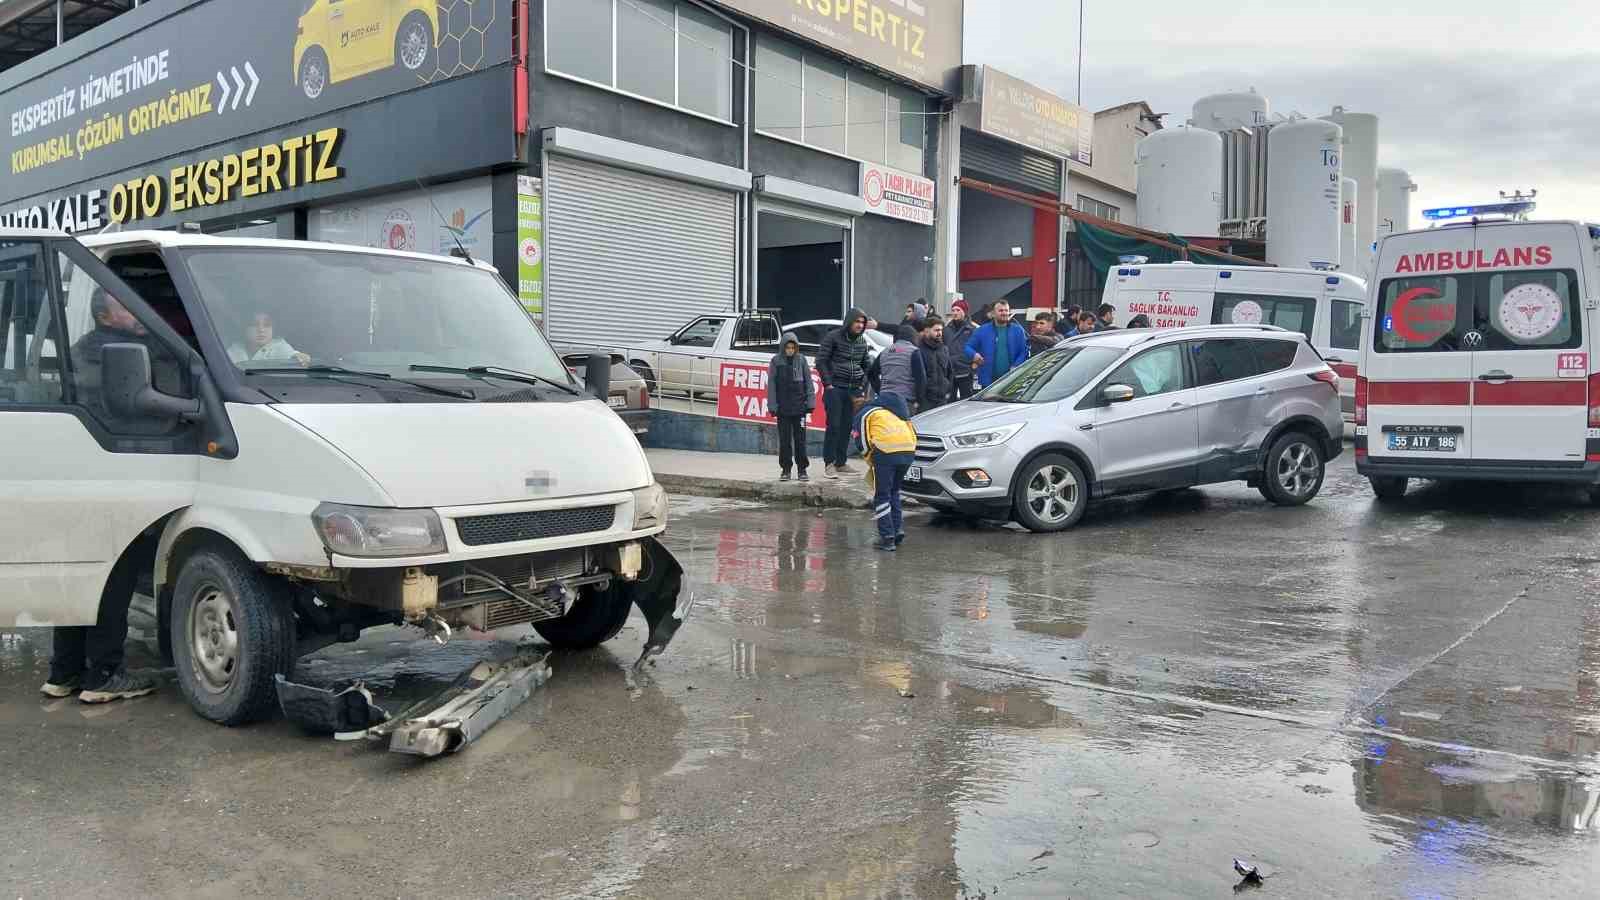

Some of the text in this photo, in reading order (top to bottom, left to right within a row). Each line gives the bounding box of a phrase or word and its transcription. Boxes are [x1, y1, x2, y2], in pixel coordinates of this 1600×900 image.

[11, 49, 169, 137] EKSPERTİZ HİZMETİNDE
[12, 83, 213, 174] KURUMSAL ÇÖZÜM ORTAĞINIZ
[0, 128, 338, 233] UTO KALE OTO EKSPERTİZ
[1396, 245, 1552, 273] AMBULANS
[1158, 291, 1172, 302] T.C.
[1129, 302, 1199, 316] SAĞLIK BAKANLIĞI
[1562, 355, 1584, 369] 112
[1395, 436, 1455, 448] 55 ATY 186
